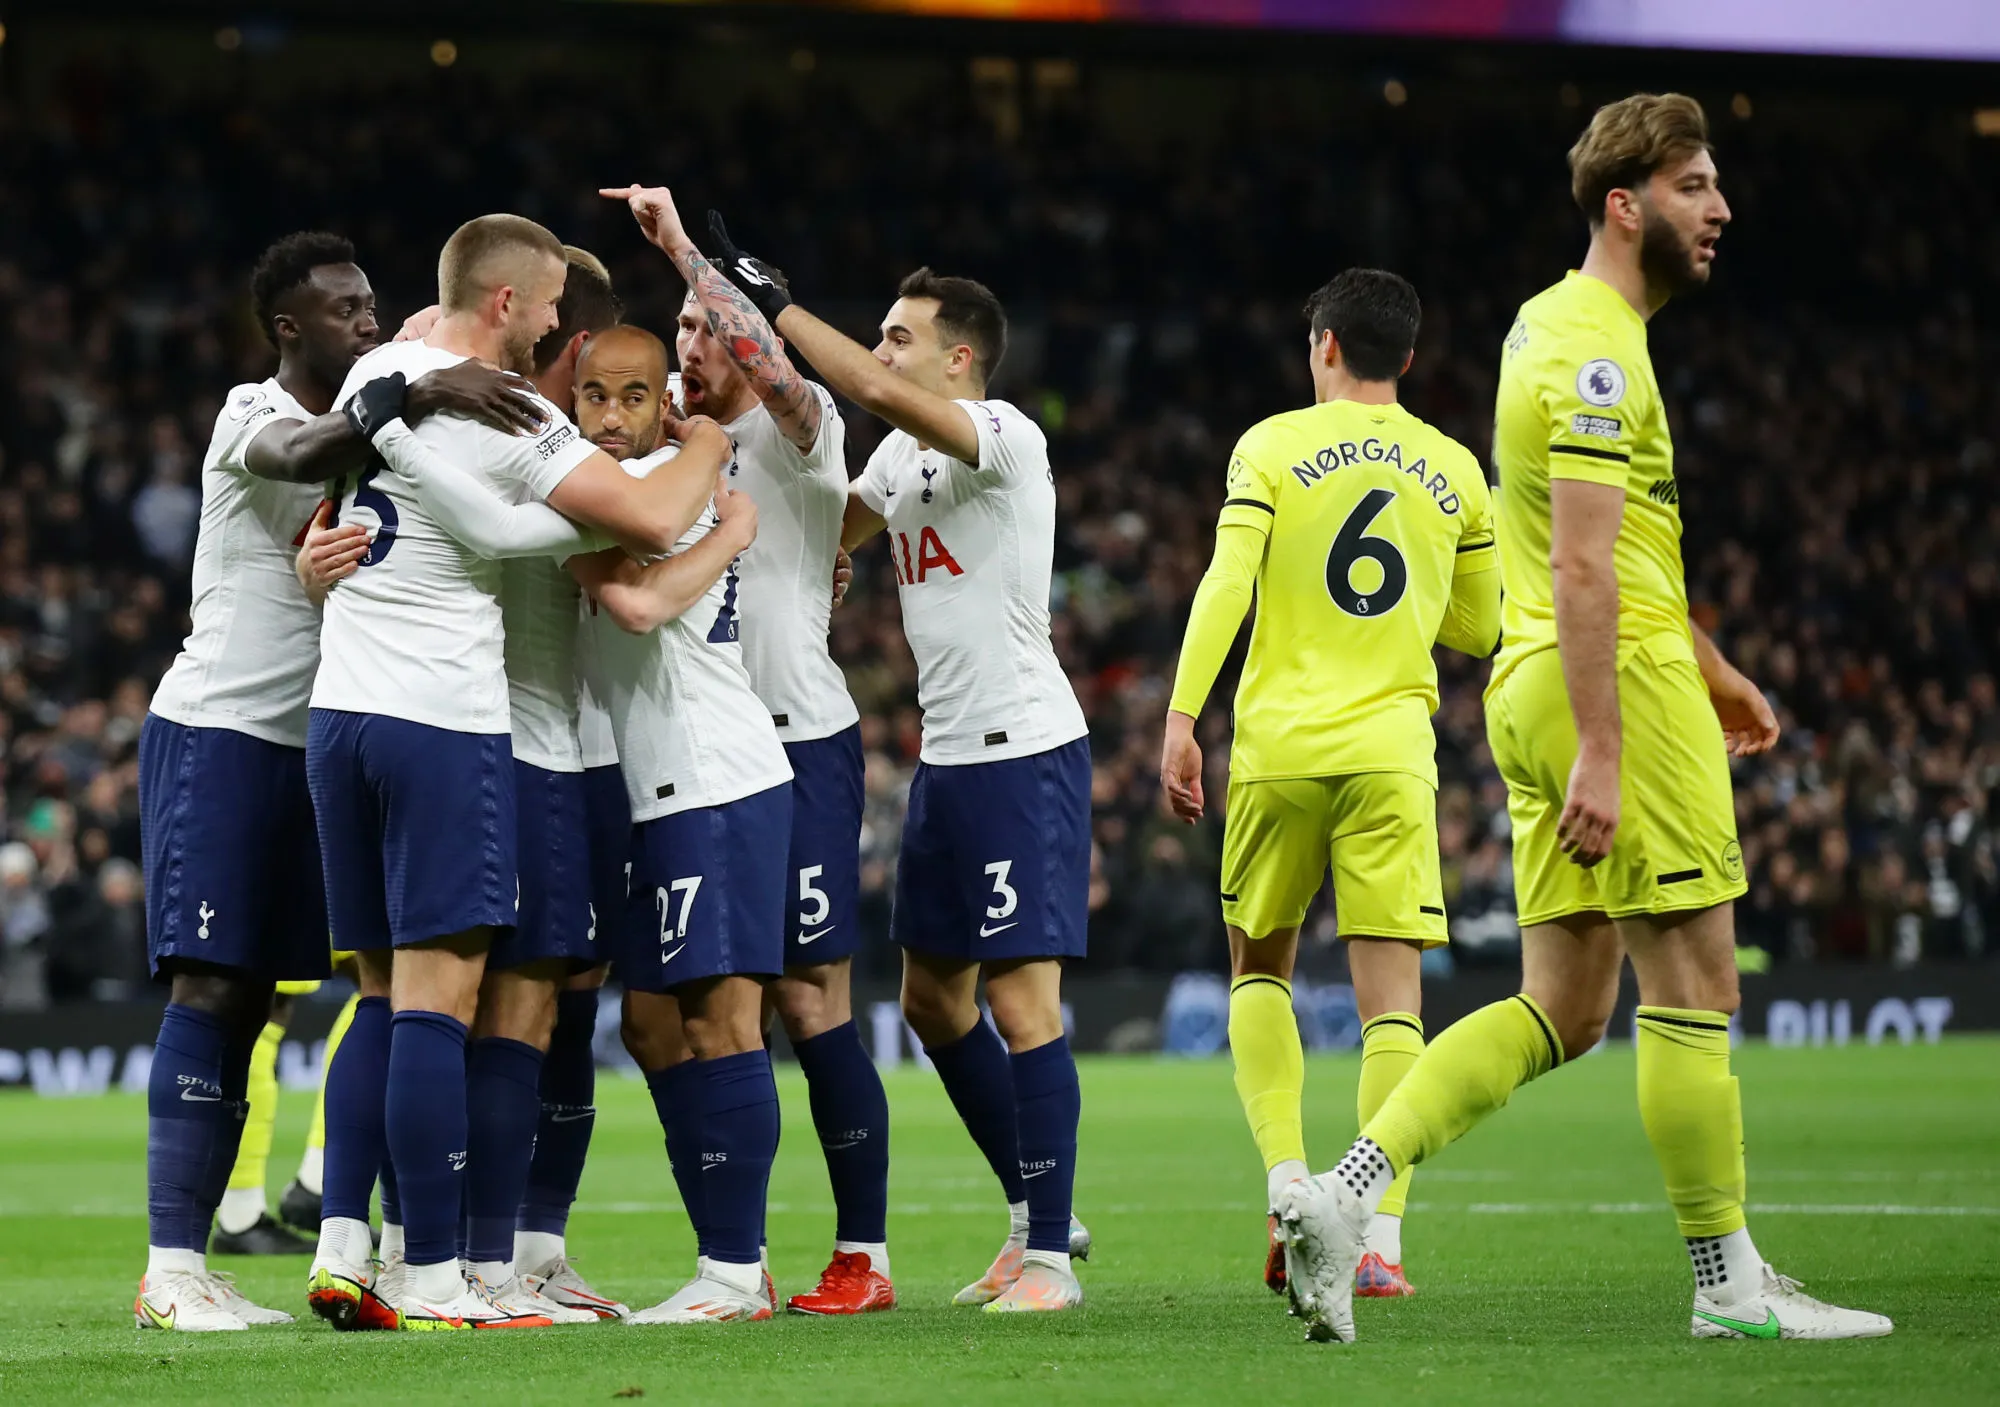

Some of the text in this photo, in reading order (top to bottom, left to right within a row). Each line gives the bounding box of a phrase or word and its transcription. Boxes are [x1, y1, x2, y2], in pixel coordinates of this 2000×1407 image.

[535, 427, 571, 456] No room
[1291, 438, 1460, 515] NØRGAARD
[1325, 488, 1408, 618] 6
[656, 875, 703, 945] 27
[800, 864, 830, 926] 5
[984, 860, 1018, 919] 3
[177, 1074, 223, 1096] SPUR
